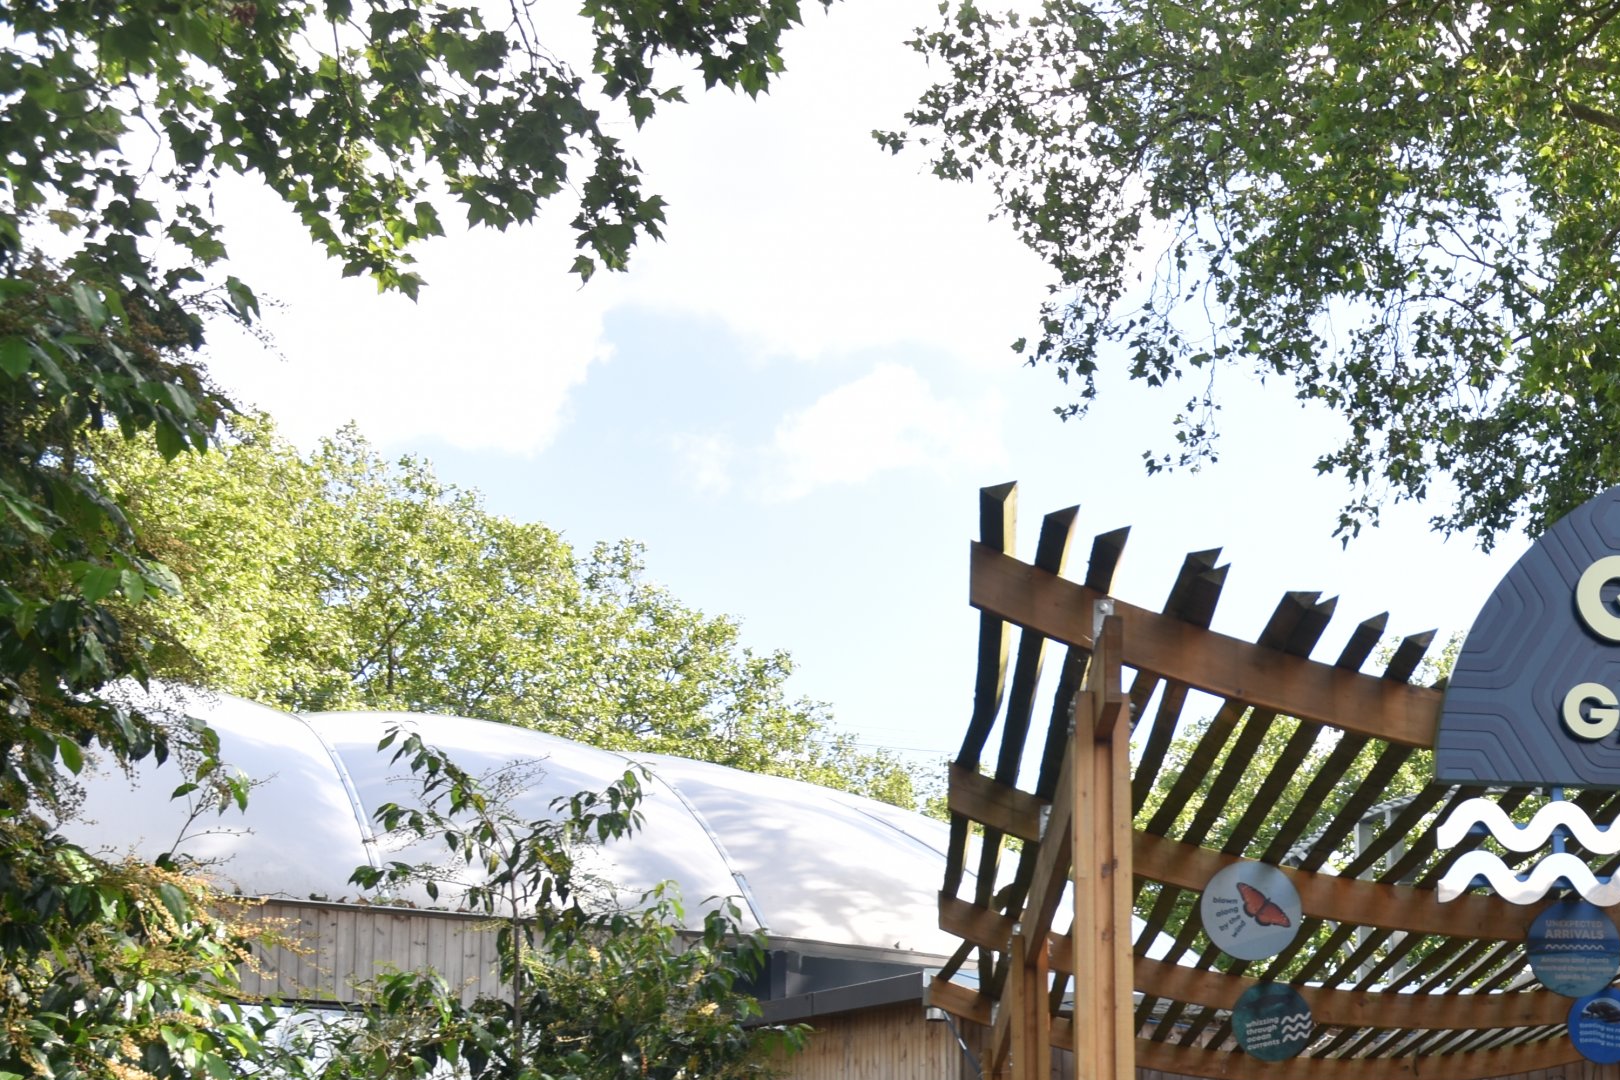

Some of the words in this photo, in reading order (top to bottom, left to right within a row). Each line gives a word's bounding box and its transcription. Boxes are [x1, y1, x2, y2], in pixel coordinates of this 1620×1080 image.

[1213, 896, 1238, 904] blown
[1216, 907, 1239, 918] along
[1219, 922, 1229, 932] by
[1229, 914, 1242, 925] the
[1232, 920, 1246, 938] wind
[1545, 919, 1602, 928] UNEXPECTED
[1545, 928, 1605, 940] ARRIVALS
[1246, 1016, 1280, 1029] whizzing
[1246, 1024, 1277, 1036] through
[1246, 1033, 1271, 1043] ocean
[1246, 1038, 1281, 1050] currents
